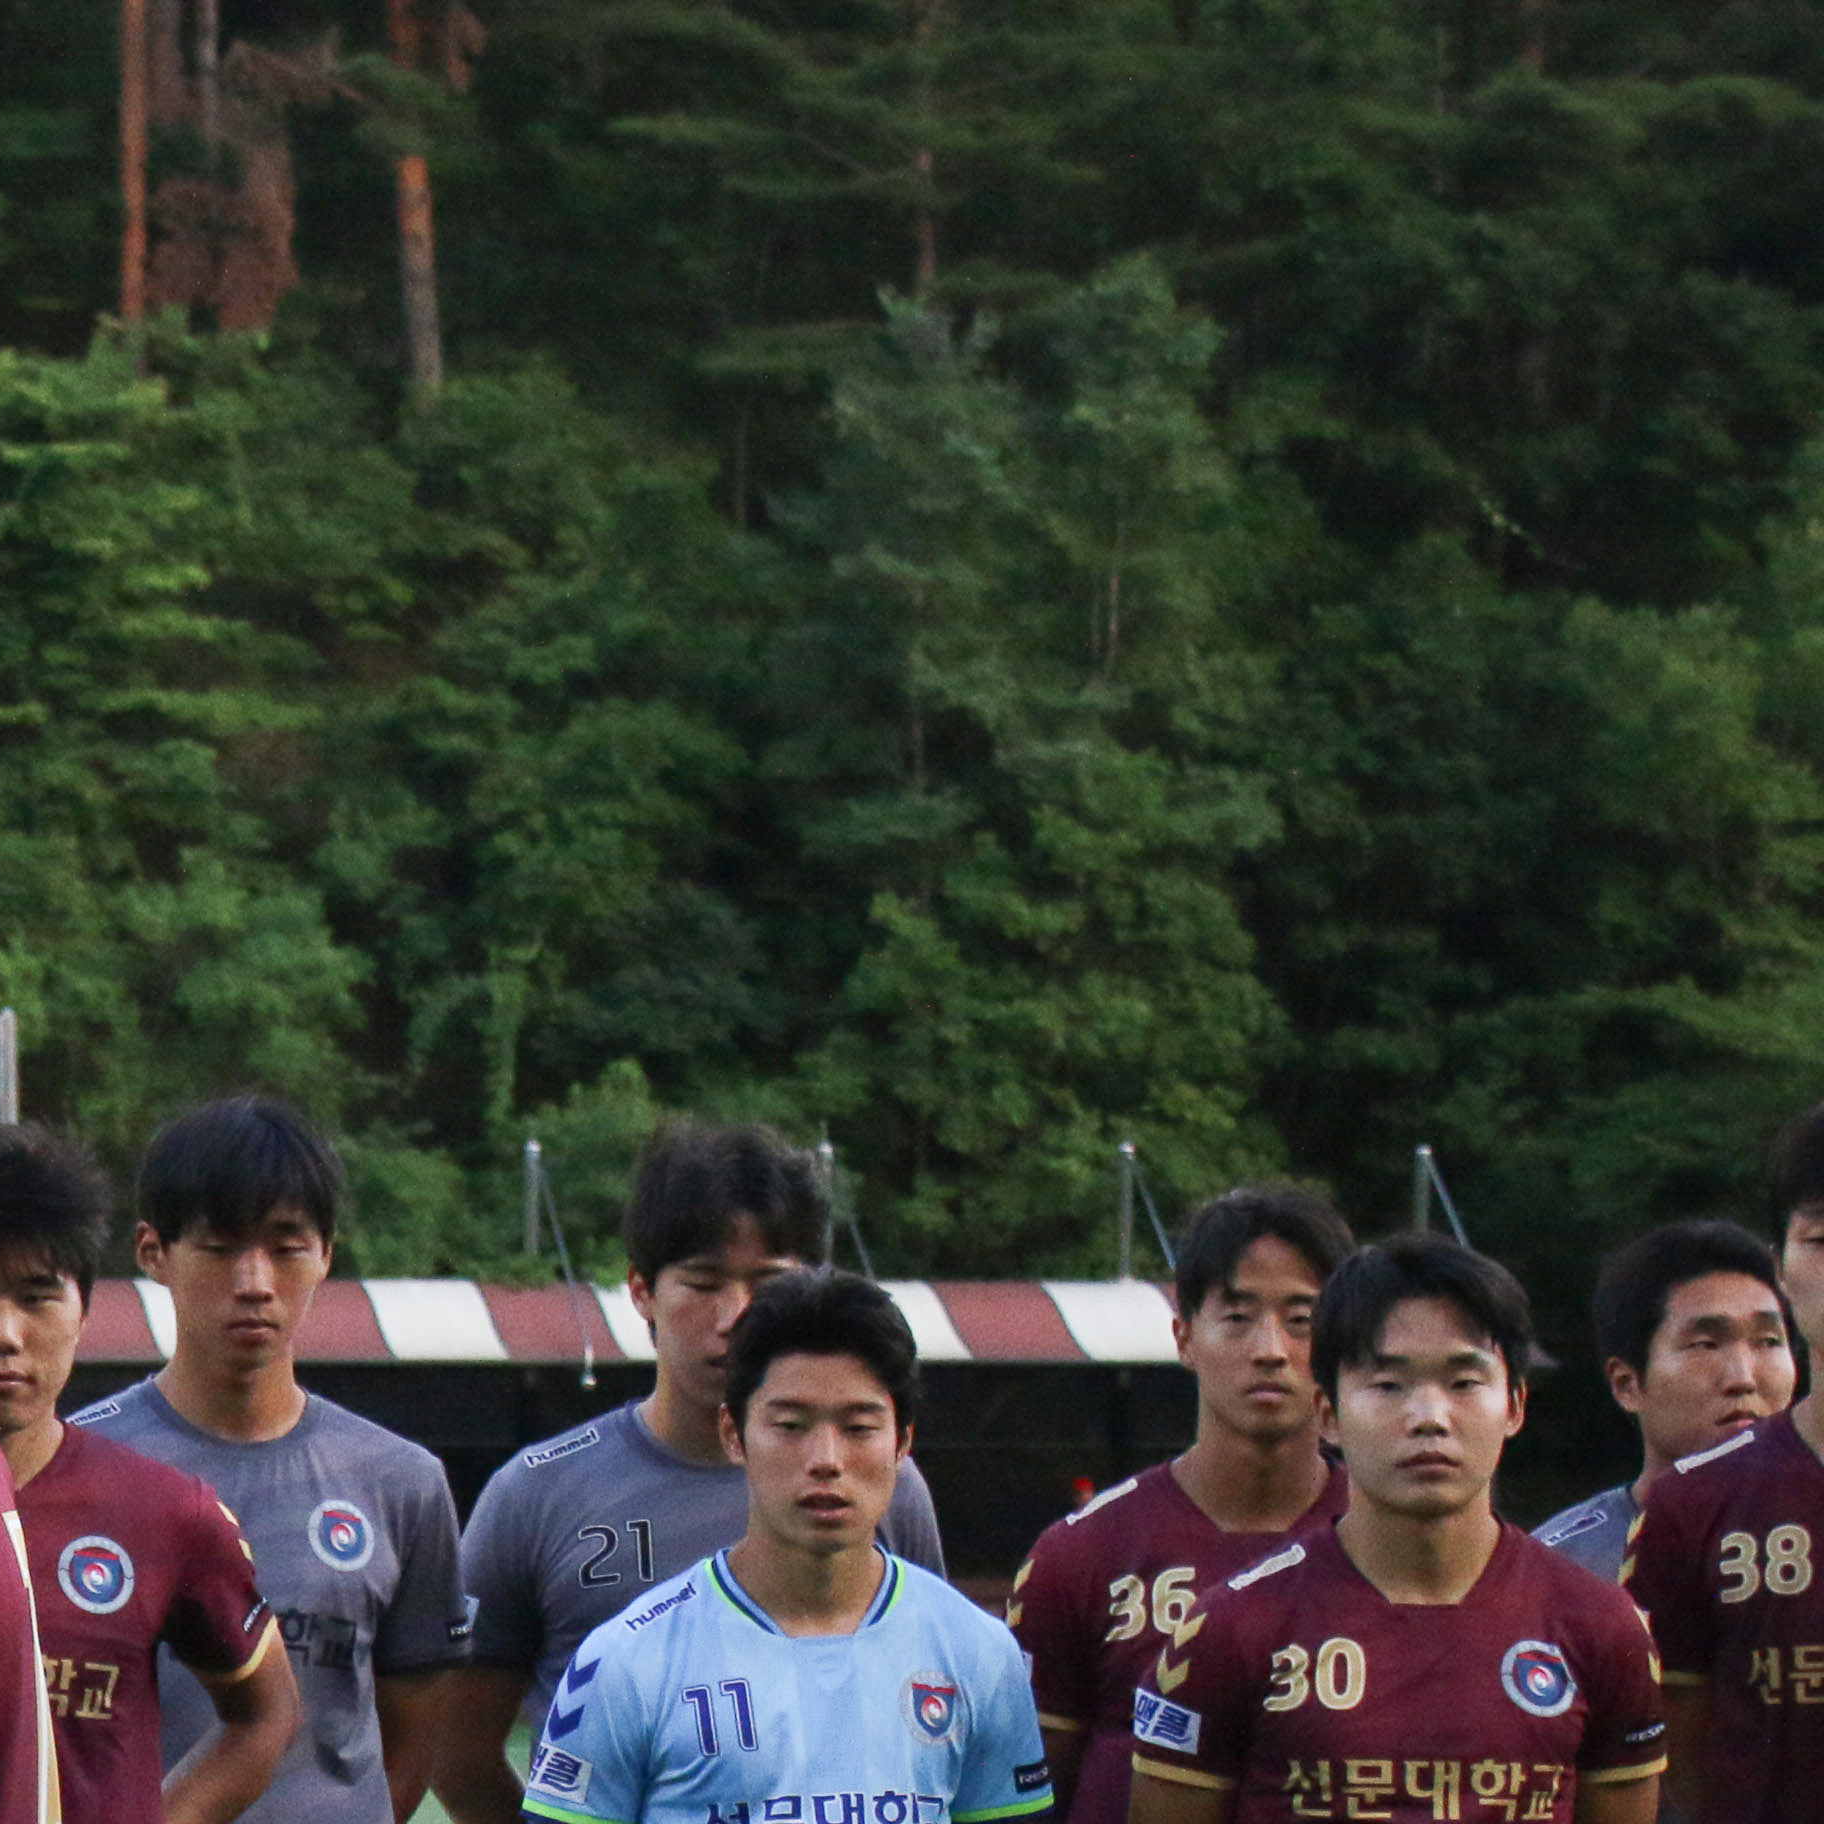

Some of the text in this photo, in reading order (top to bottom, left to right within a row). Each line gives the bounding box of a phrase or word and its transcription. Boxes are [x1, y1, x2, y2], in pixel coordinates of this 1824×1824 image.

[525, 1427, 600, 1468] hummel
[578, 1518, 654, 1589] 21
[1719, 1523, 1813, 1604] 38
[625, 1581, 698, 1634] hummel
[1105, 1566, 1197, 1643] 36
[1261, 1636, 1367, 1712] 30
[680, 1677, 759, 1758] 11
[1282, 1757, 1565, 1822] 선문대학교
